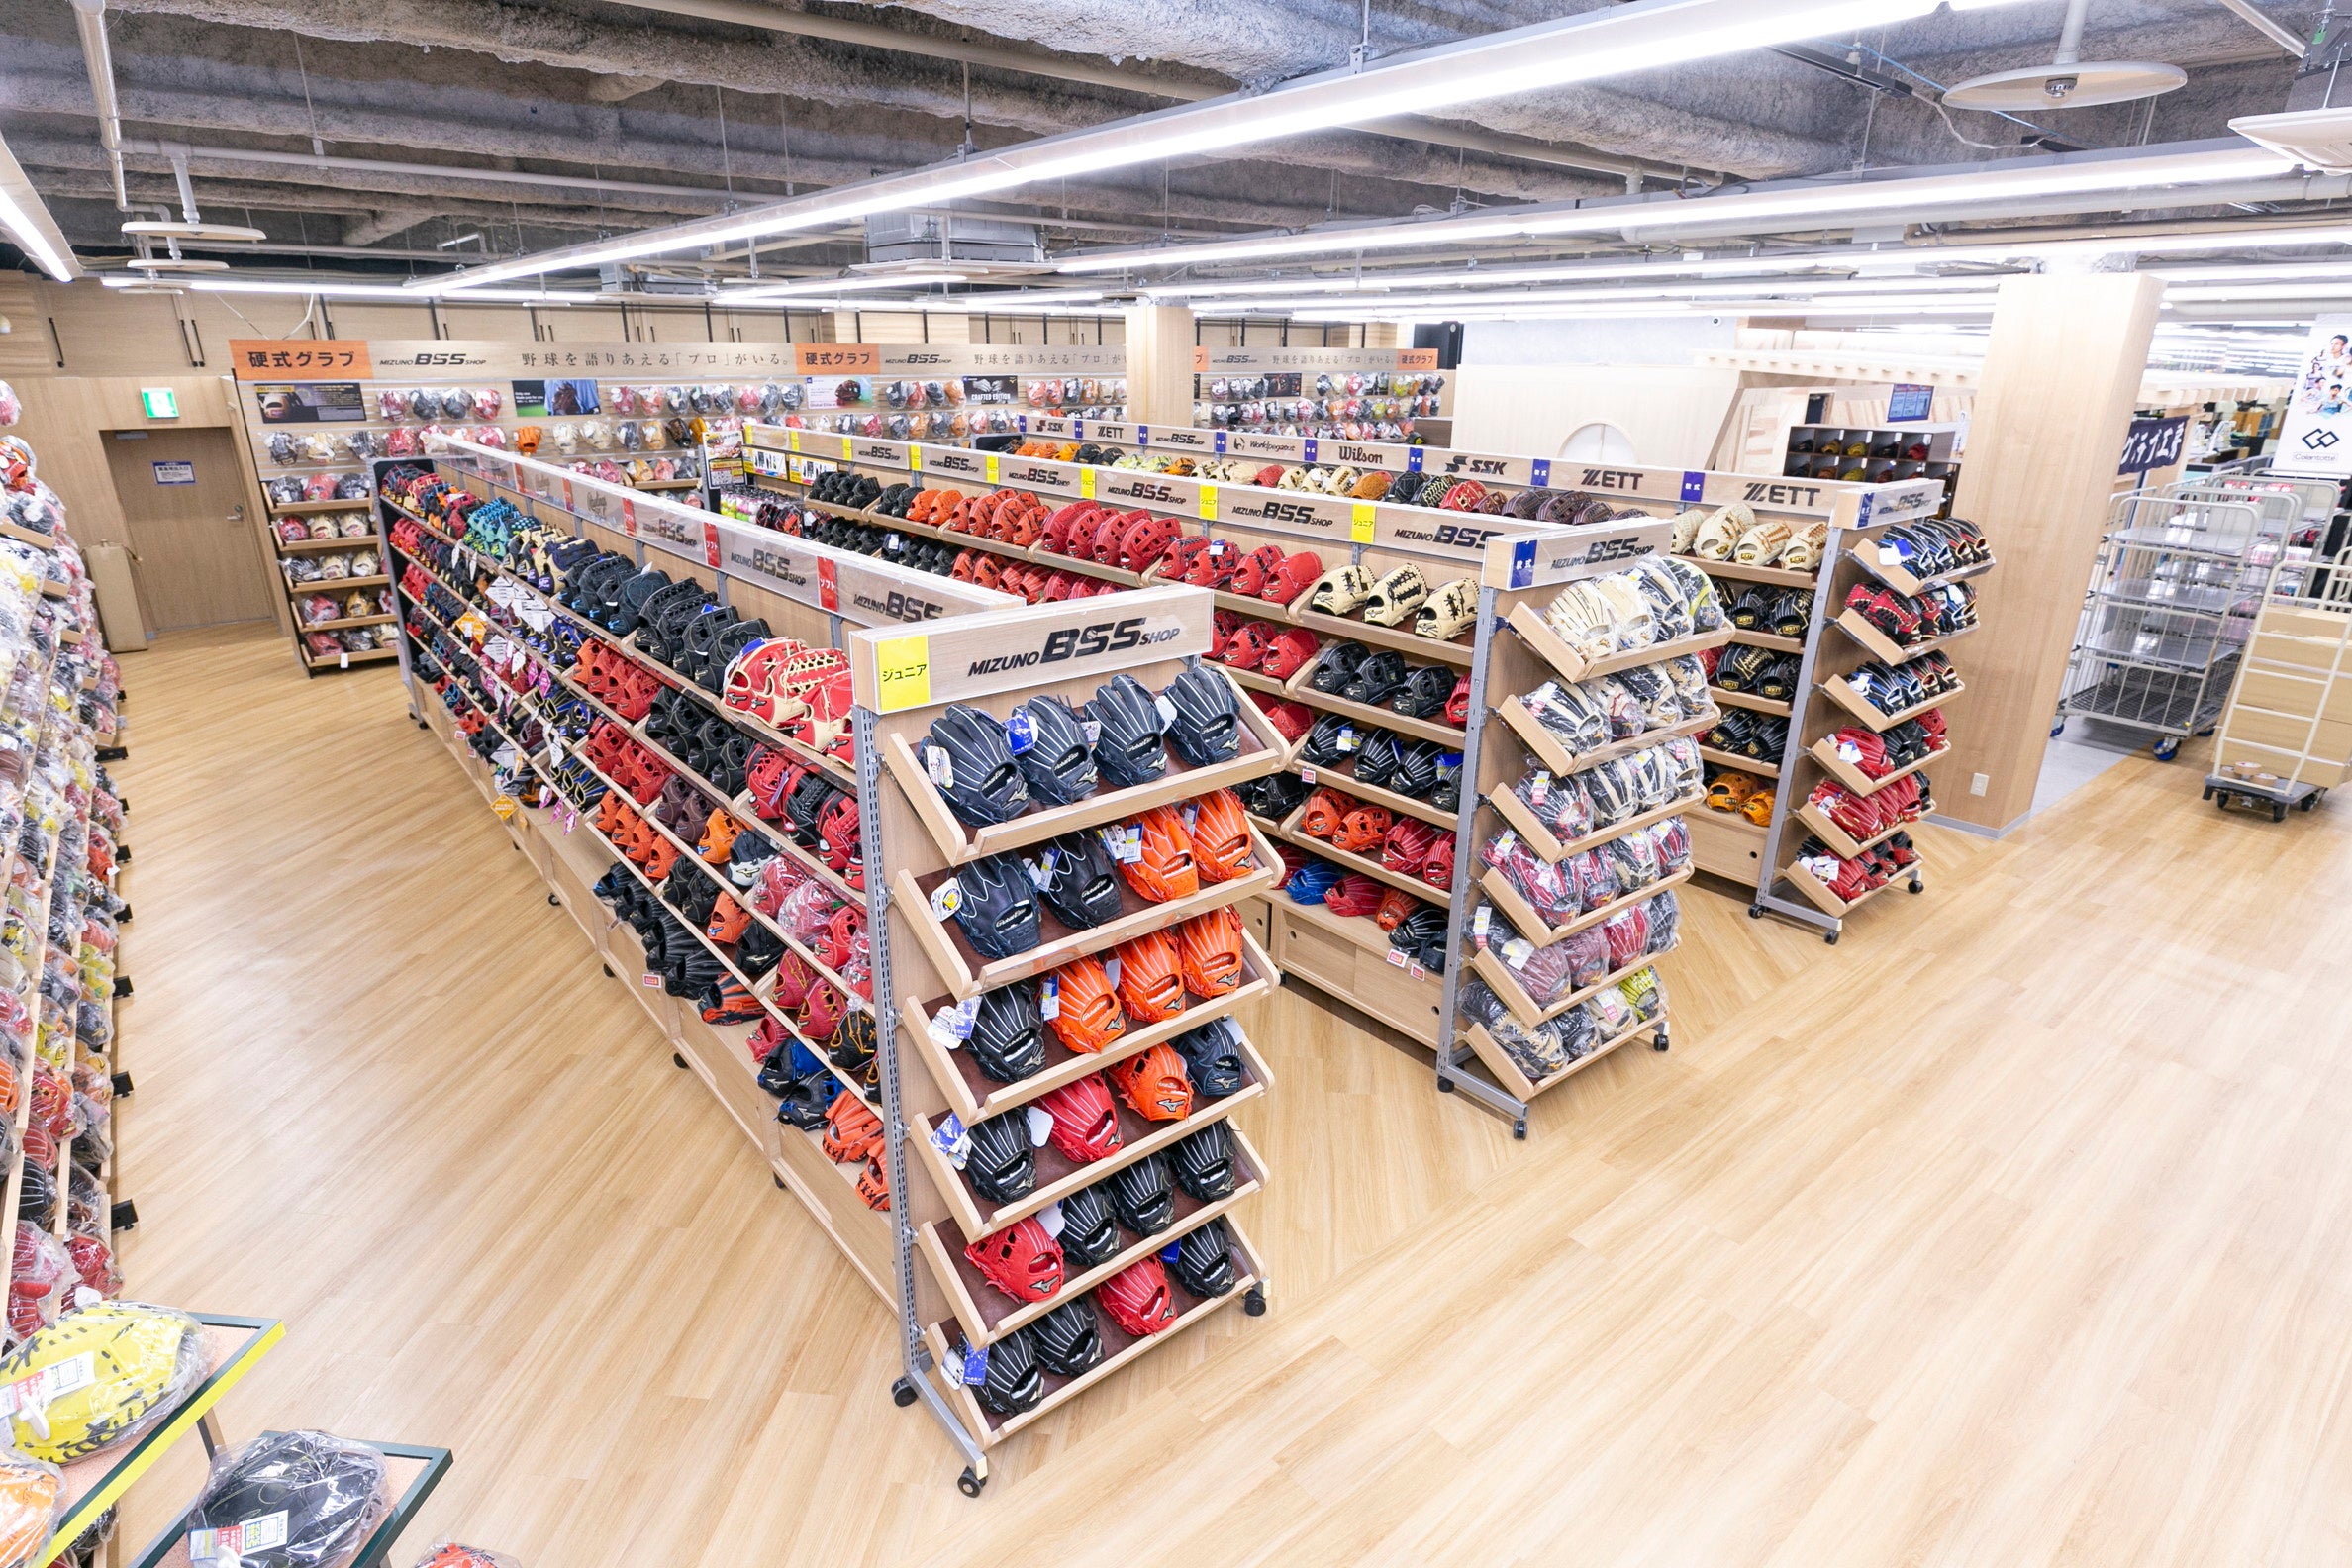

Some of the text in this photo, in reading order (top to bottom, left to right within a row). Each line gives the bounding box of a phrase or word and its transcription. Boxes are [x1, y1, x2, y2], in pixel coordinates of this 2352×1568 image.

[248, 351, 354, 368] 硬式グラブ
[414, 353, 467, 366] BSS
[521, 352, 789, 367] 野球を語りあえる「プロ」がいる。
[806, 352, 870, 365] 硬式グラブ
[906, 354, 940, 363] BSS
[1098, 427, 1124, 439] ZETT
[1171, 434, 1196, 444] BSS
[871, 446, 892, 459] BSS
[1338, 446, 1383, 464] Wilson
[943, 456, 969, 471] BSS
[1469, 459, 1508, 475] SSK
[1027, 468, 1059, 485] BSS
[1581, 468, 1644, 490] ZETT
[1108, 482, 1187, 505] MIZUNO BSS SHOP
[1743, 482, 1821, 507] ZETT
[1232, 501, 1333, 528] MIZUNO BSS SHOP
[1353, 518, 1374, 527] ジュニア
[1395, 529, 1433, 542] MIZUNO
[1550, 537, 1655, 571] MIZUNO BSS SHOP
[731, 548, 807, 587] MIZUNO BSS SHOP
[1516, 558, 1532, 571] 軟式
[820, 578, 835, 591] ソフト
[853, 594, 886, 614] MIZUNO
[967, 617, 1180, 678] MIZUNO BSS SHOP
[881, 663, 928, 683] ジュニア
